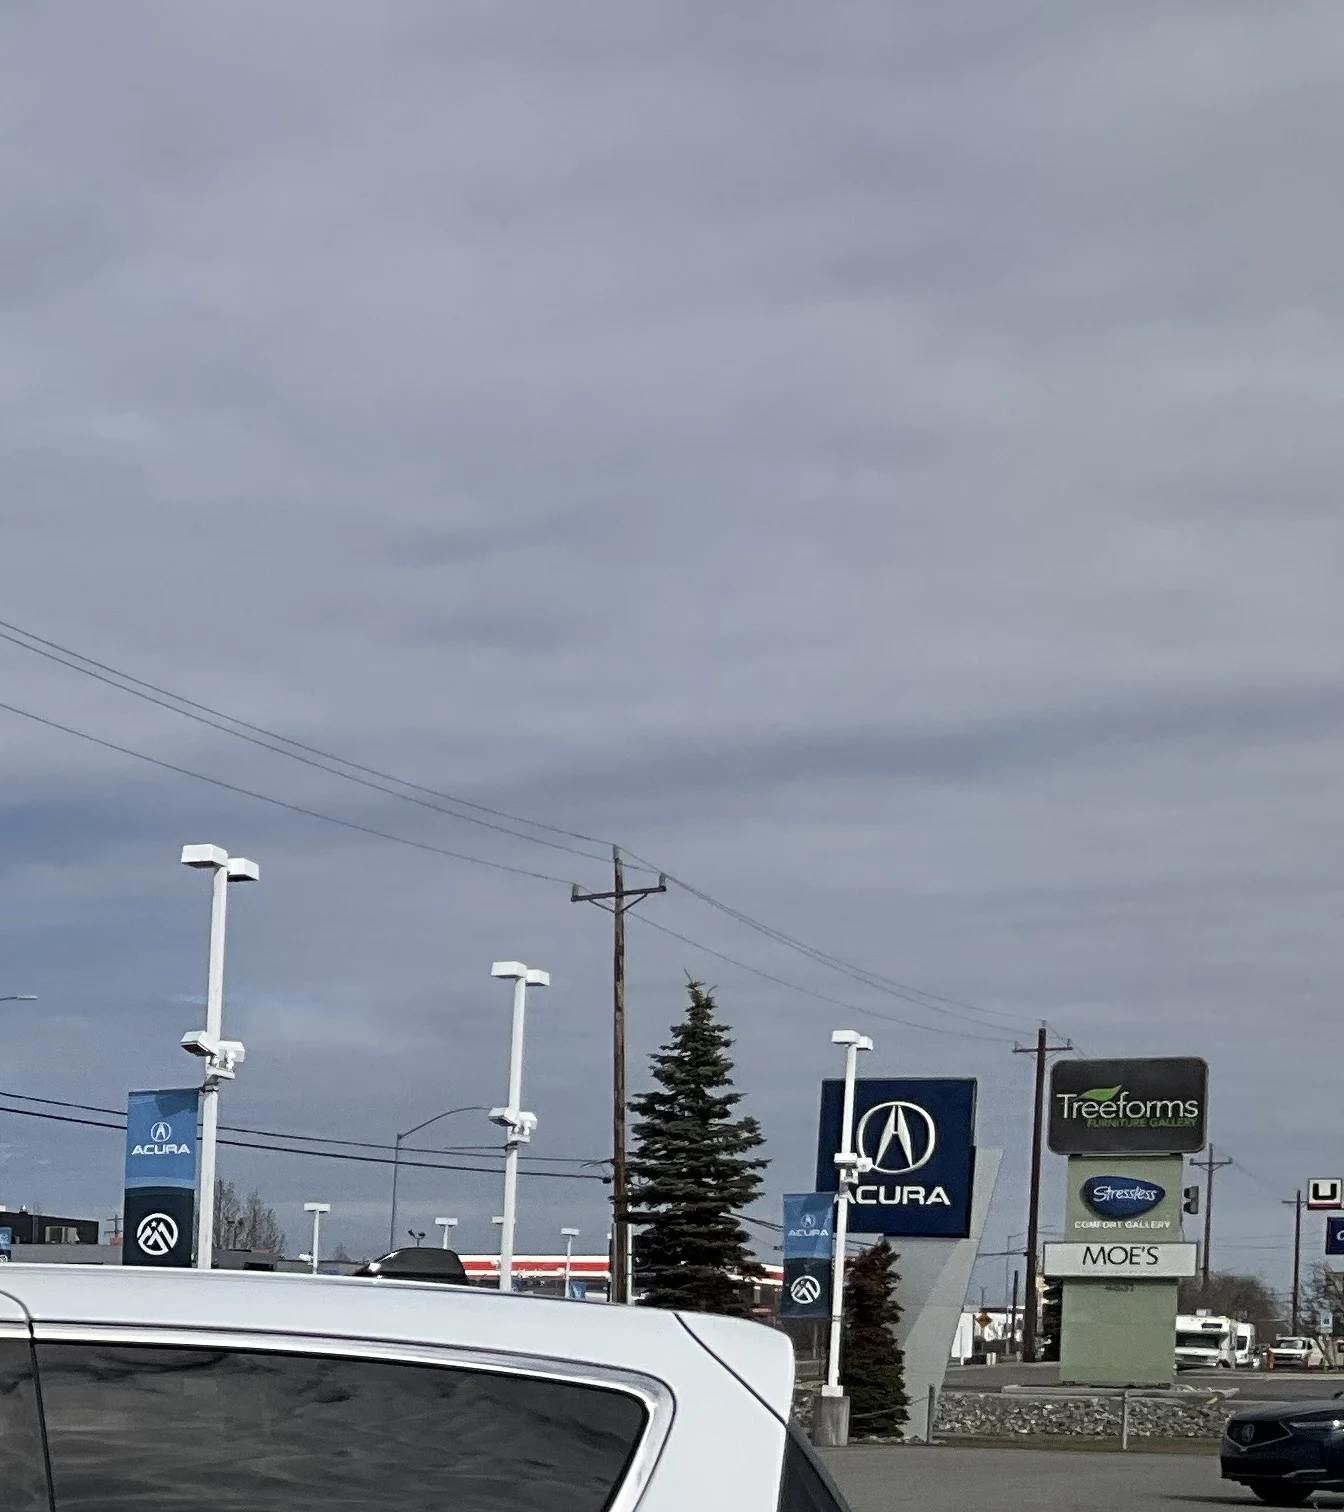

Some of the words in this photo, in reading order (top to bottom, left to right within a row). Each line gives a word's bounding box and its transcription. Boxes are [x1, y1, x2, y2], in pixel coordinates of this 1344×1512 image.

[1056, 1091, 1199, 1119] Treeforms
[1087, 1118, 1147, 1128] FURNITURE
[1149, 1118, 1199, 1128] GALLERY
[131, 1143, 191, 1155] ACURA
[1093, 1185, 1158, 1202] Stressless
[1074, 1220, 1122, 1229] COMFORT
[1124, 1220, 1171, 1229] GALLERY
[787, 1229, 829, 1237] ACURA
[1082, 1245, 1159, 1265] MOE'S
